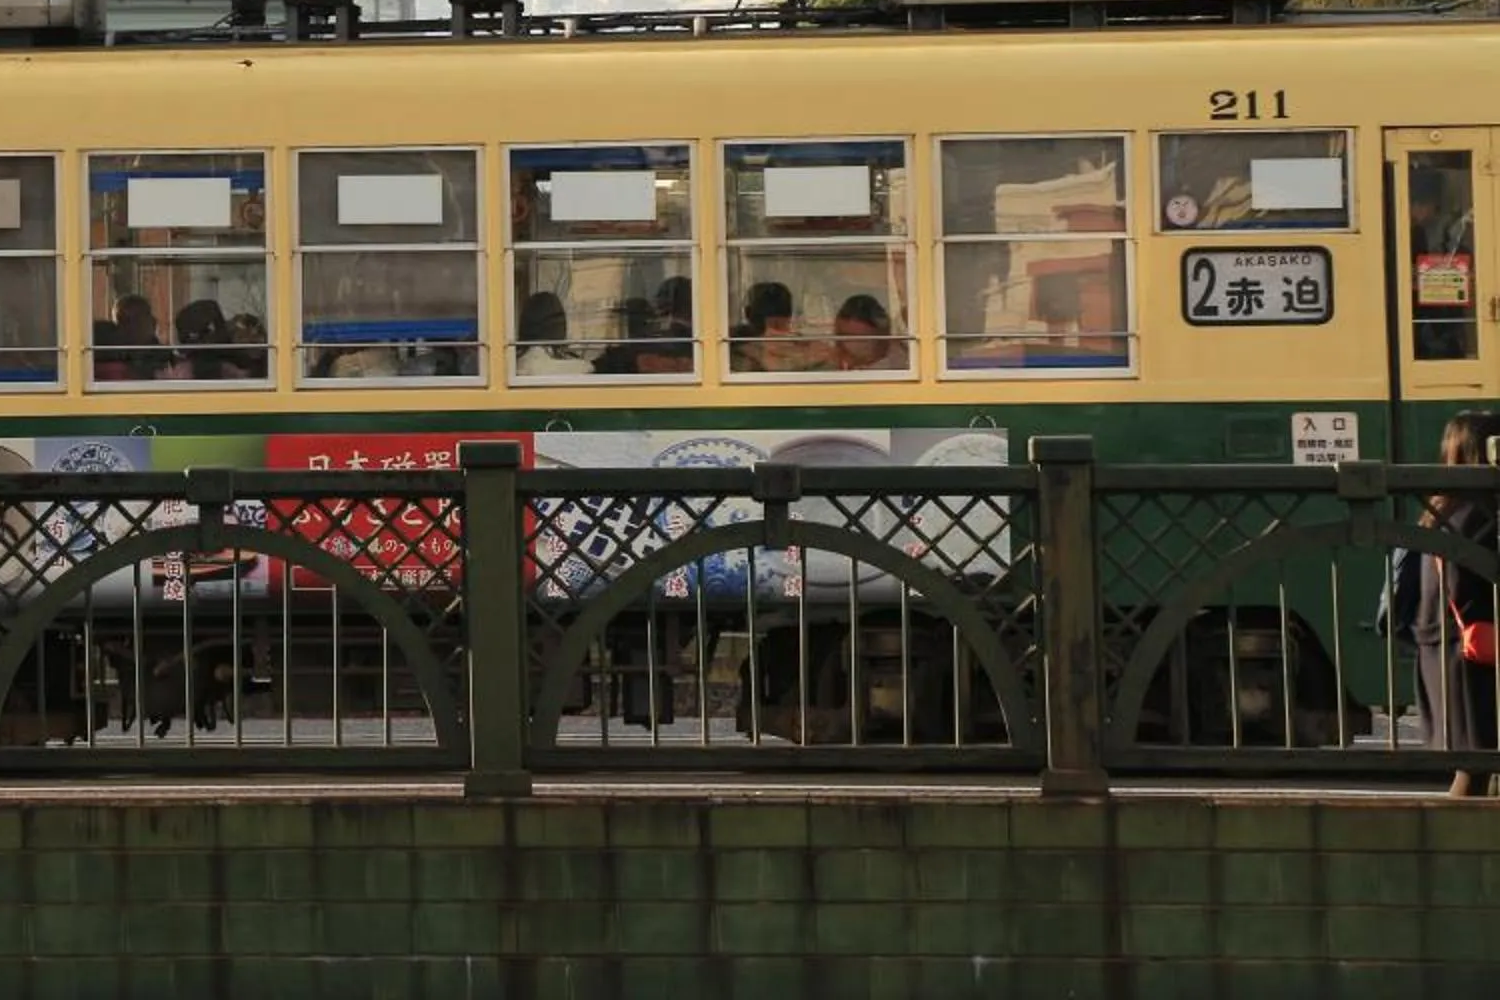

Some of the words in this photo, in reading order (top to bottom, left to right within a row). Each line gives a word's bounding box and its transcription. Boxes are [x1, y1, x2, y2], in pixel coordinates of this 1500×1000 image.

[1209, 89, 1290, 120] 211
[1234, 254, 1312, 267] AKASAKO
[1193, 258, 1219, 316] 2
[1226, 276, 1324, 315] 赤迫
[1303, 416, 1345, 431] 入口
